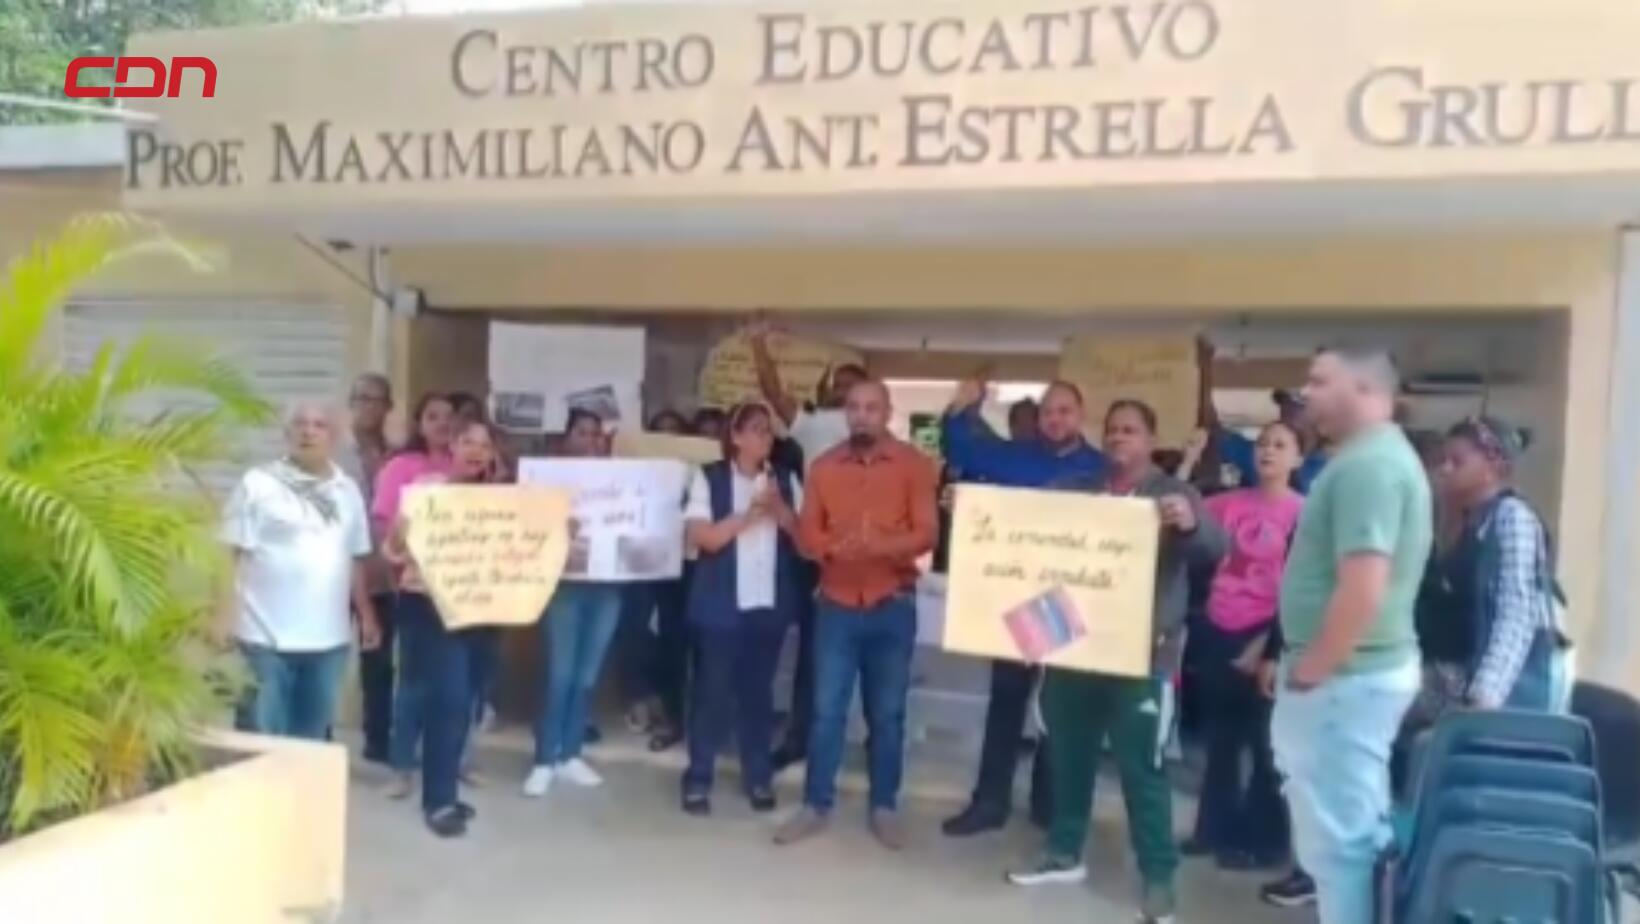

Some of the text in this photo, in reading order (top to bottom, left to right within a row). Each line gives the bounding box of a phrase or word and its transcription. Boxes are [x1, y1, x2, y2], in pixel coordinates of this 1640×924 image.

[450, 0, 1220, 99] CENTRO EDUCATIVO
[125, 131, 244, 190] PROF.
[270, 121, 706, 184] MAXIMILIANO
[724, 106, 880, 171] ANT.
[898, 94, 1296, 168] ESTRELLA
